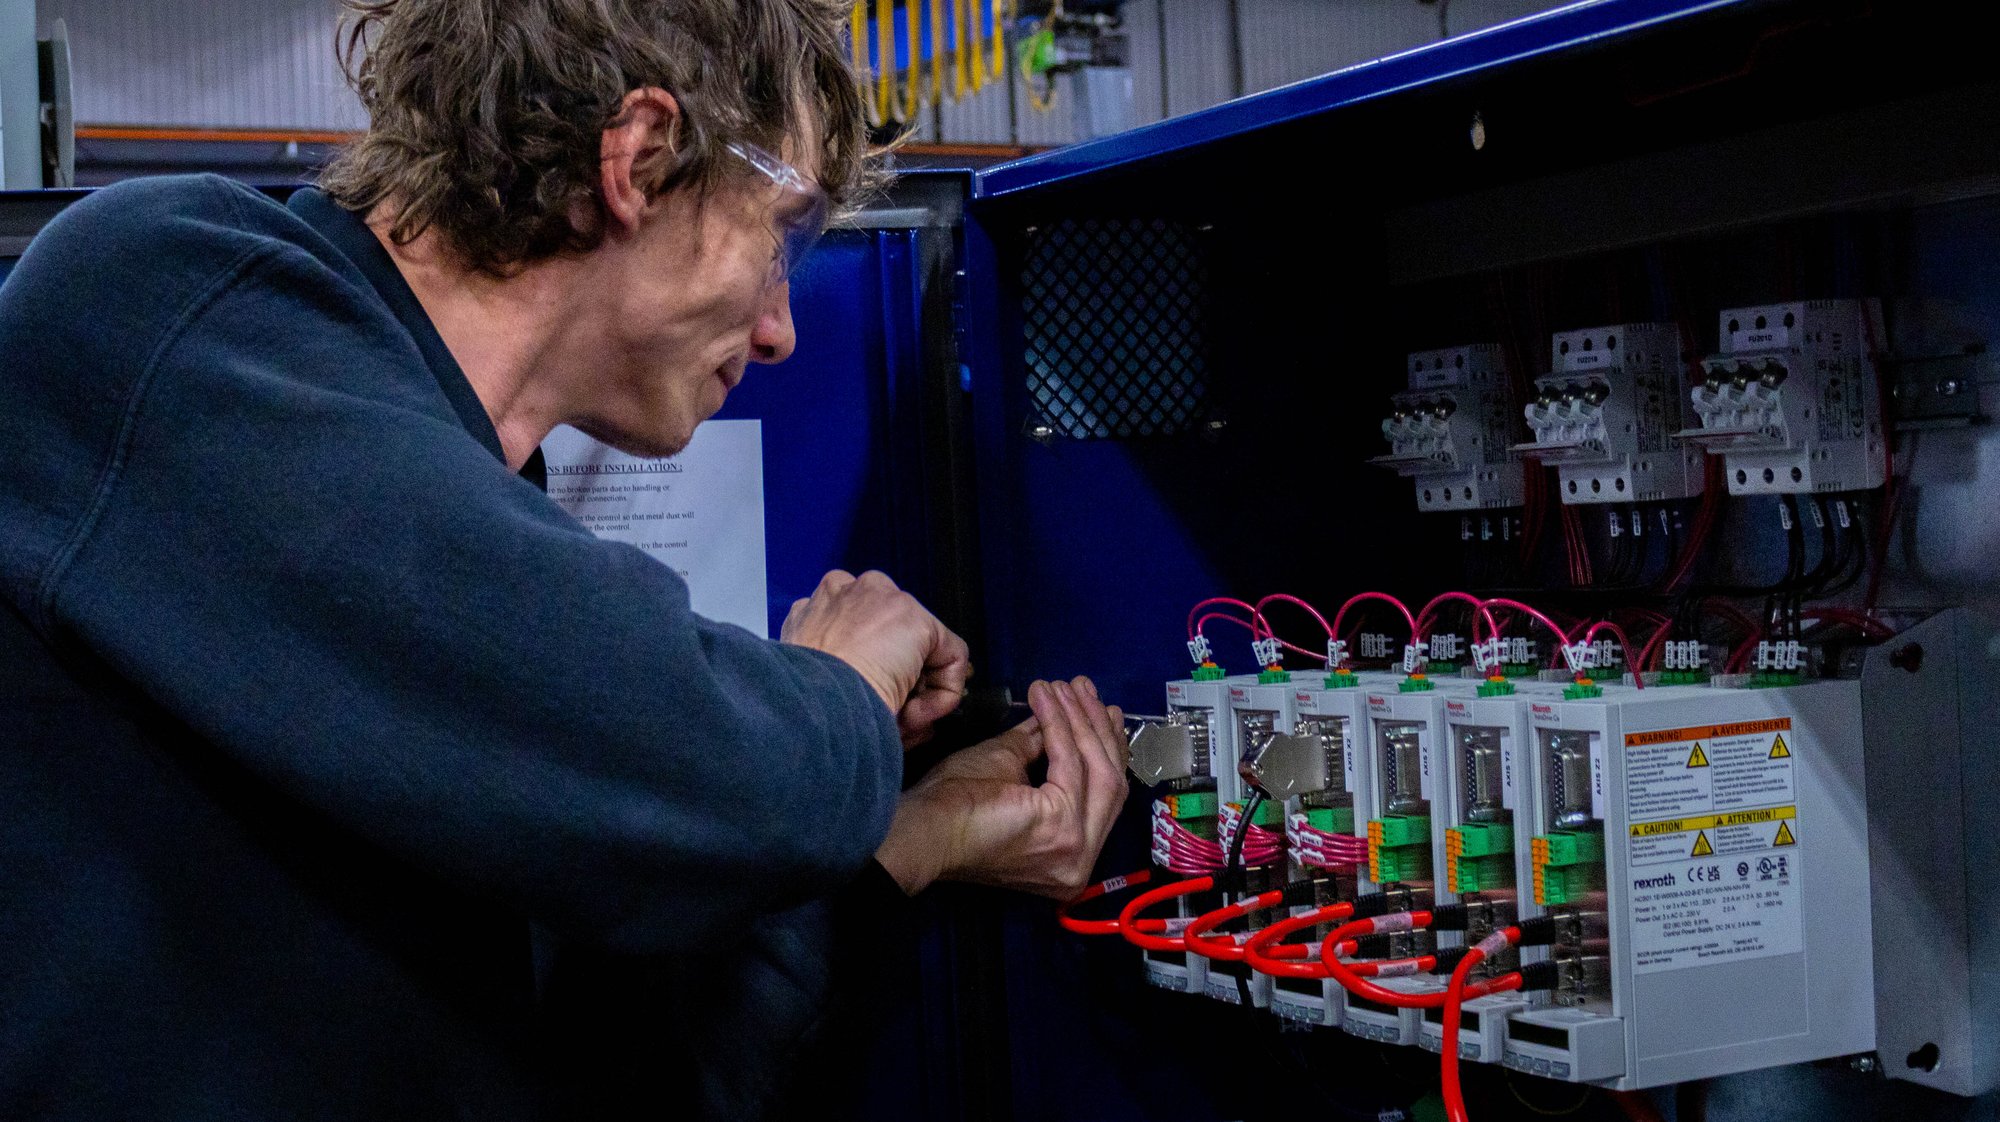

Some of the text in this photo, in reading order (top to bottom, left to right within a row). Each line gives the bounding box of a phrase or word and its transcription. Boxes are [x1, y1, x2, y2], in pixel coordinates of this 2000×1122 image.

[563, 464, 601, 473] BEFORE
[605, 463, 677, 472] INSTALLATION
[633, 484, 661, 492] handling
[646, 512, 664, 520] metal
[682, 511, 694, 519] will
[653, 540, 662, 548] the
[664, 540, 687, 548] control
[1720, 720, 1784, 735] AVERTISSEMENT
[1639, 731, 1682, 743] WARNING!
[1727, 811, 1771, 824] ATTENTION
[1644, 821, 1683, 834] CAUTION!
[1634, 872, 1676, 890] rexroth
